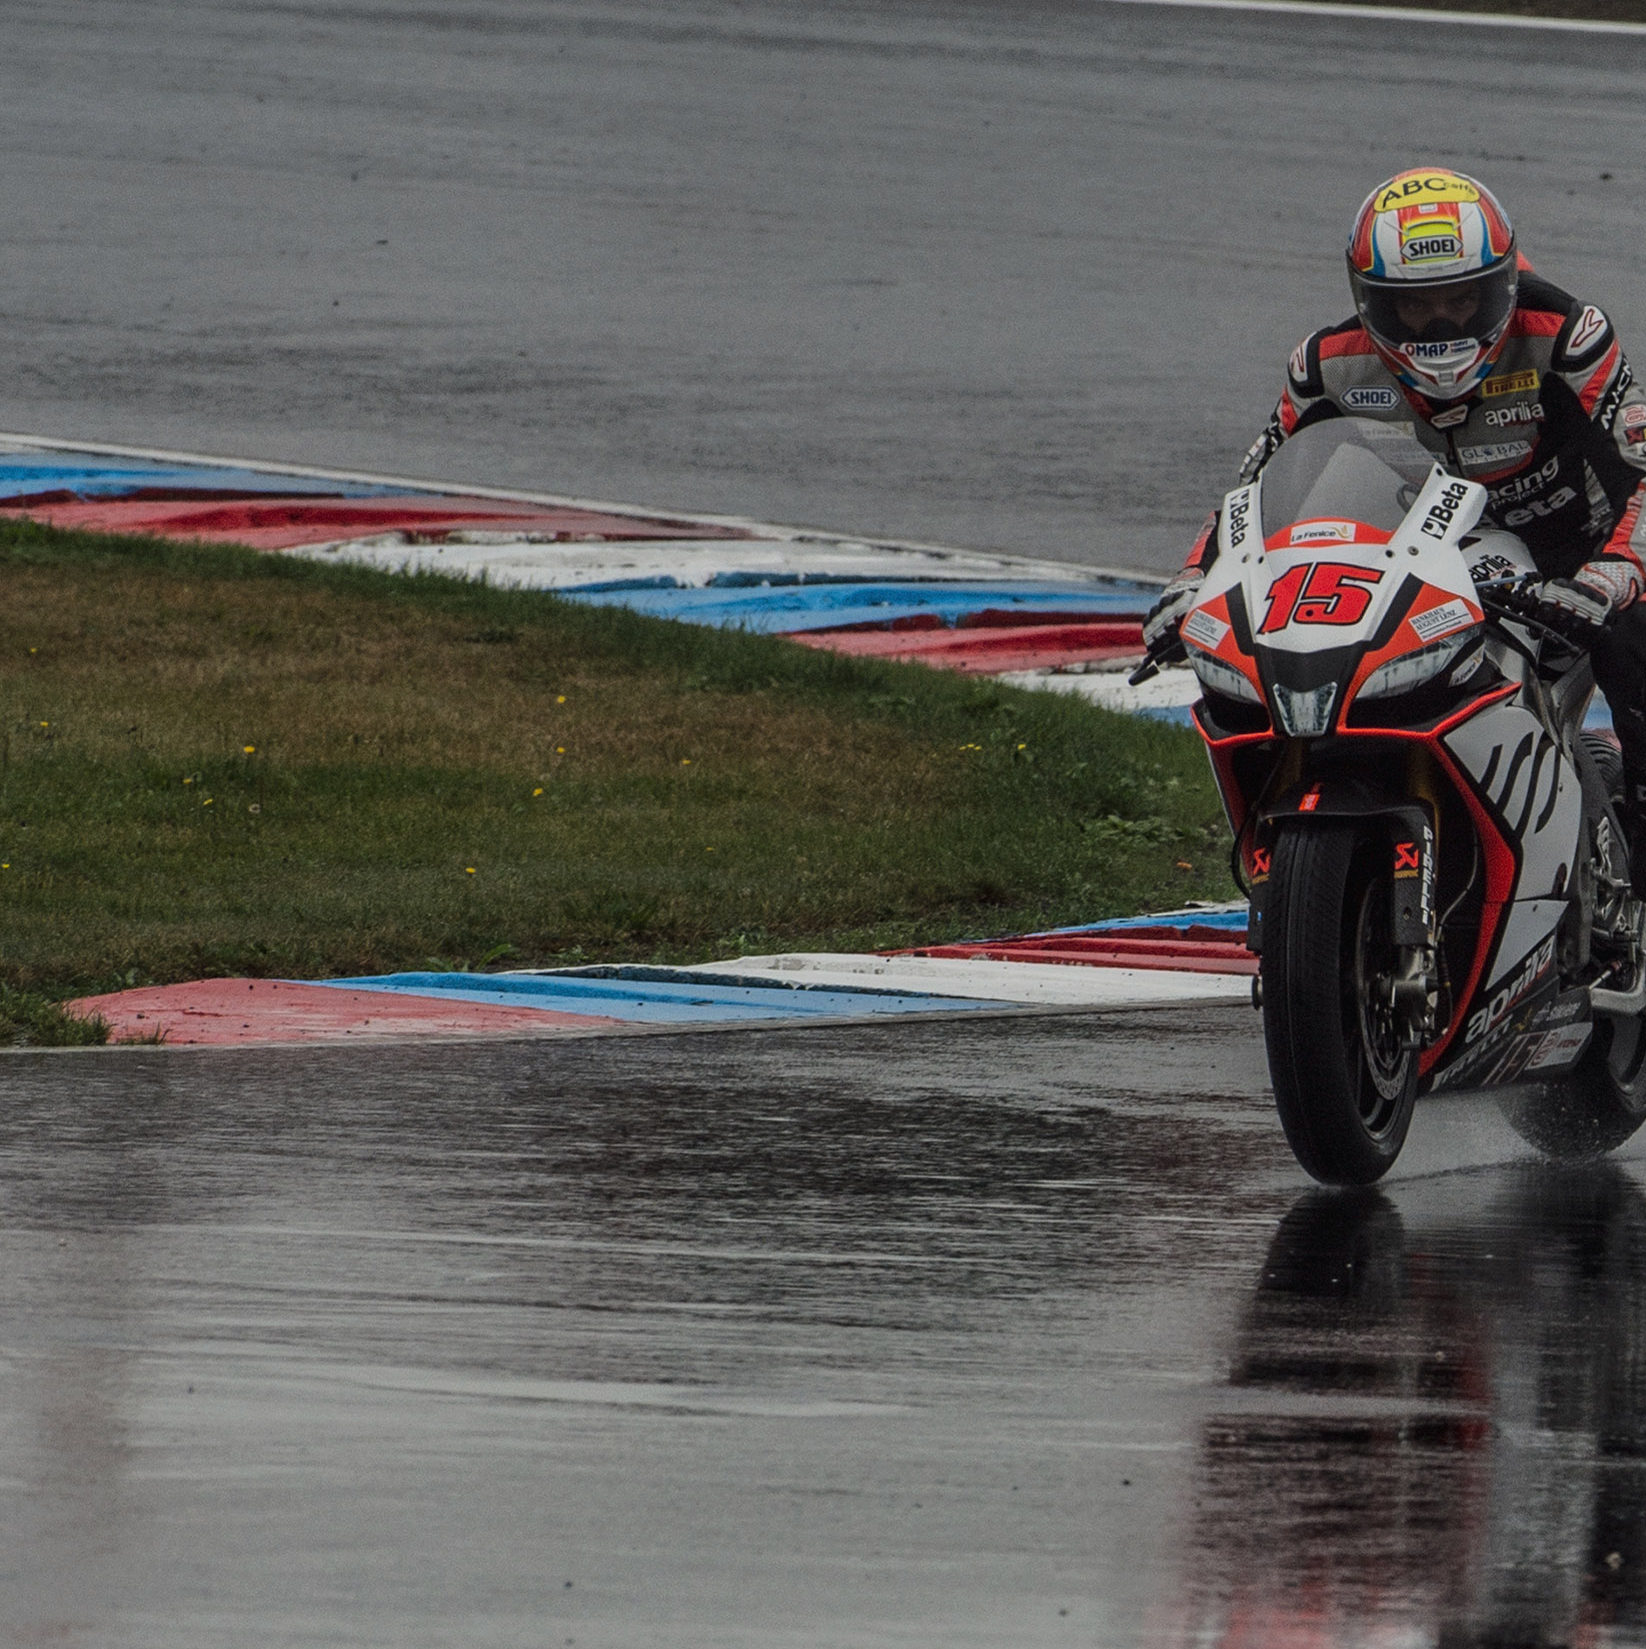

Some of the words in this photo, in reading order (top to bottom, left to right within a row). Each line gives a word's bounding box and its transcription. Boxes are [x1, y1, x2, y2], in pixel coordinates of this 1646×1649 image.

[1382, 178, 1446, 209] ABC
[1408, 239, 1455, 257] SHOEI
[1351, 391, 1392, 405] SHOEI
[1485, 372, 1536, 394] PIRELLI
[1484, 401, 1545, 427] aprilia
[1487, 456, 1559, 501] acing
[1428, 482, 1469, 524] Beta
[1500, 486, 1577, 527] eta
[1231, 501, 1250, 549] Beta
[1469, 553, 1513, 583] aprilia
[1256, 561, 1386, 636] 15
[1465, 934, 1555, 1044] aprilia
